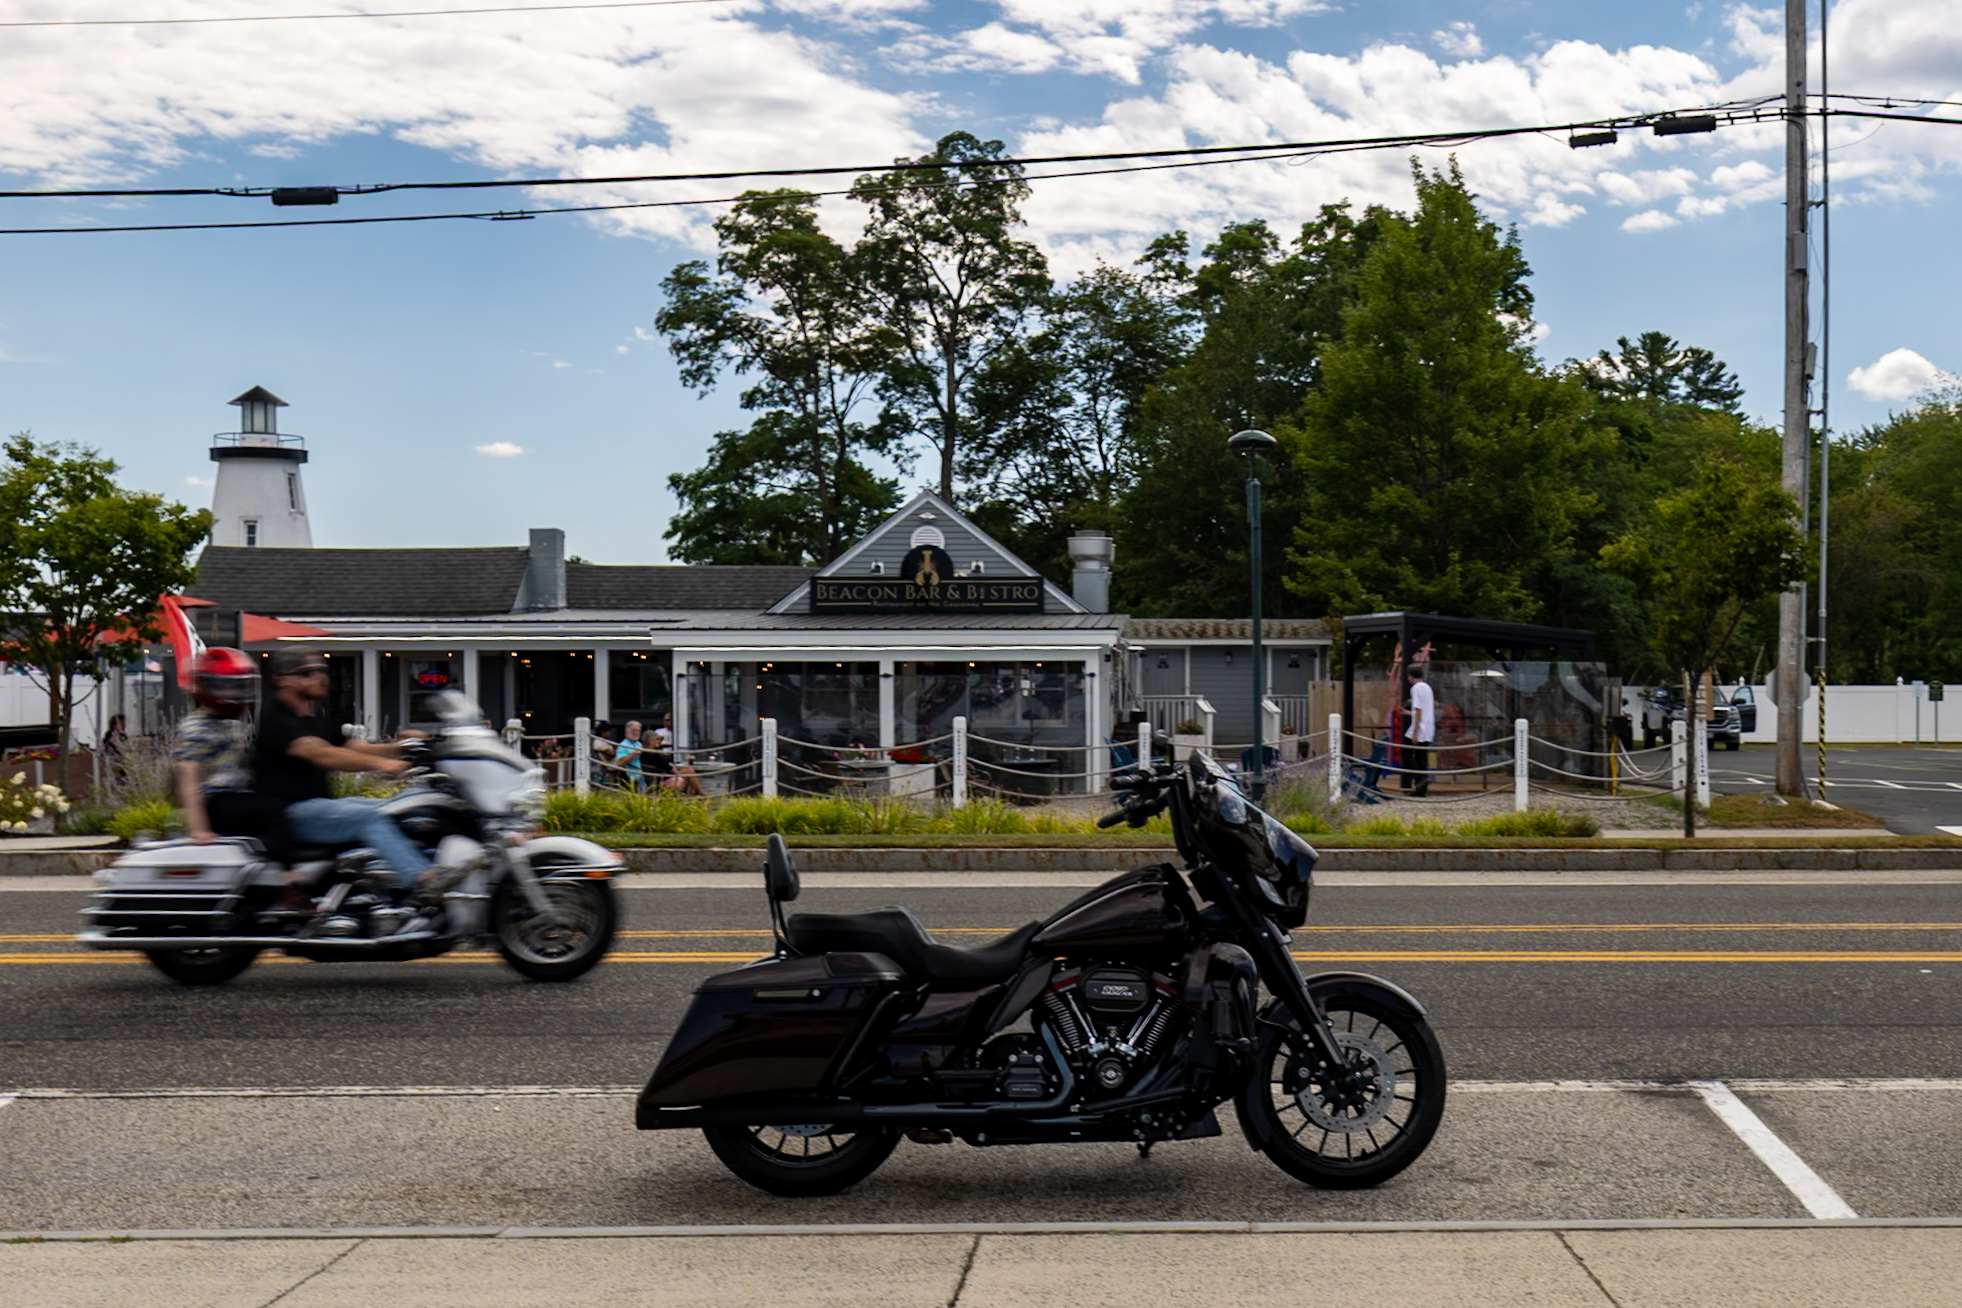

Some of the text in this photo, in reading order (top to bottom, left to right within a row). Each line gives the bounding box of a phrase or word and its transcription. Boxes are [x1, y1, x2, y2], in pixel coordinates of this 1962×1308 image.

[816, 584, 898, 600] BEACON
[905, 584, 941, 600] BAR
[946, 584, 961, 600] &
[418, 673, 448, 684] OPEN
